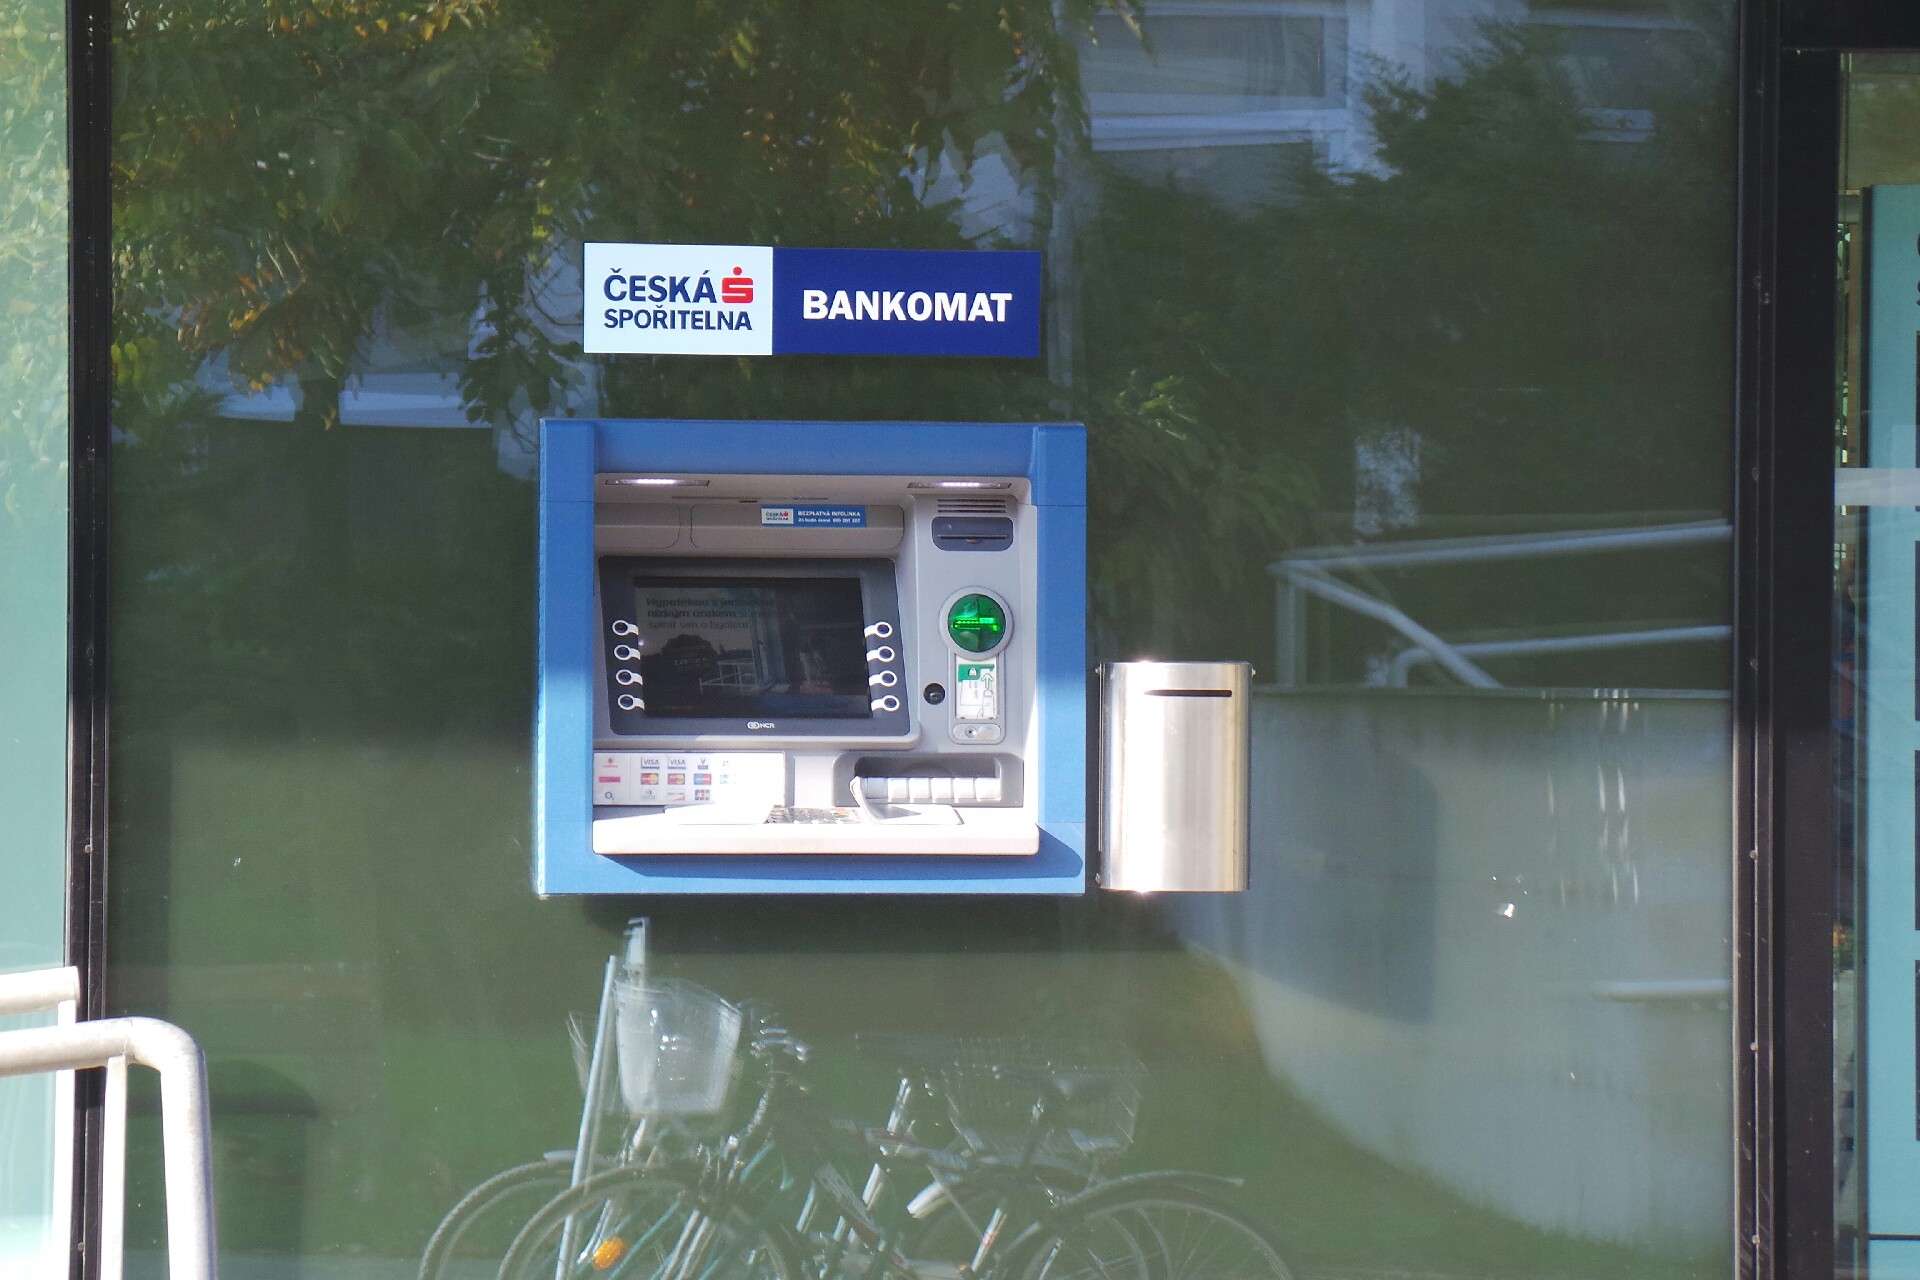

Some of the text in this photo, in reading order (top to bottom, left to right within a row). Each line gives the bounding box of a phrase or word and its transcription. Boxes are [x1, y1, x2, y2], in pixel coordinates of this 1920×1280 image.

[603, 267, 717, 303] ČESKÁ
[603, 305, 753, 331] SPOŘITELNA
[802, 289, 1013, 323] BANKOMAT
